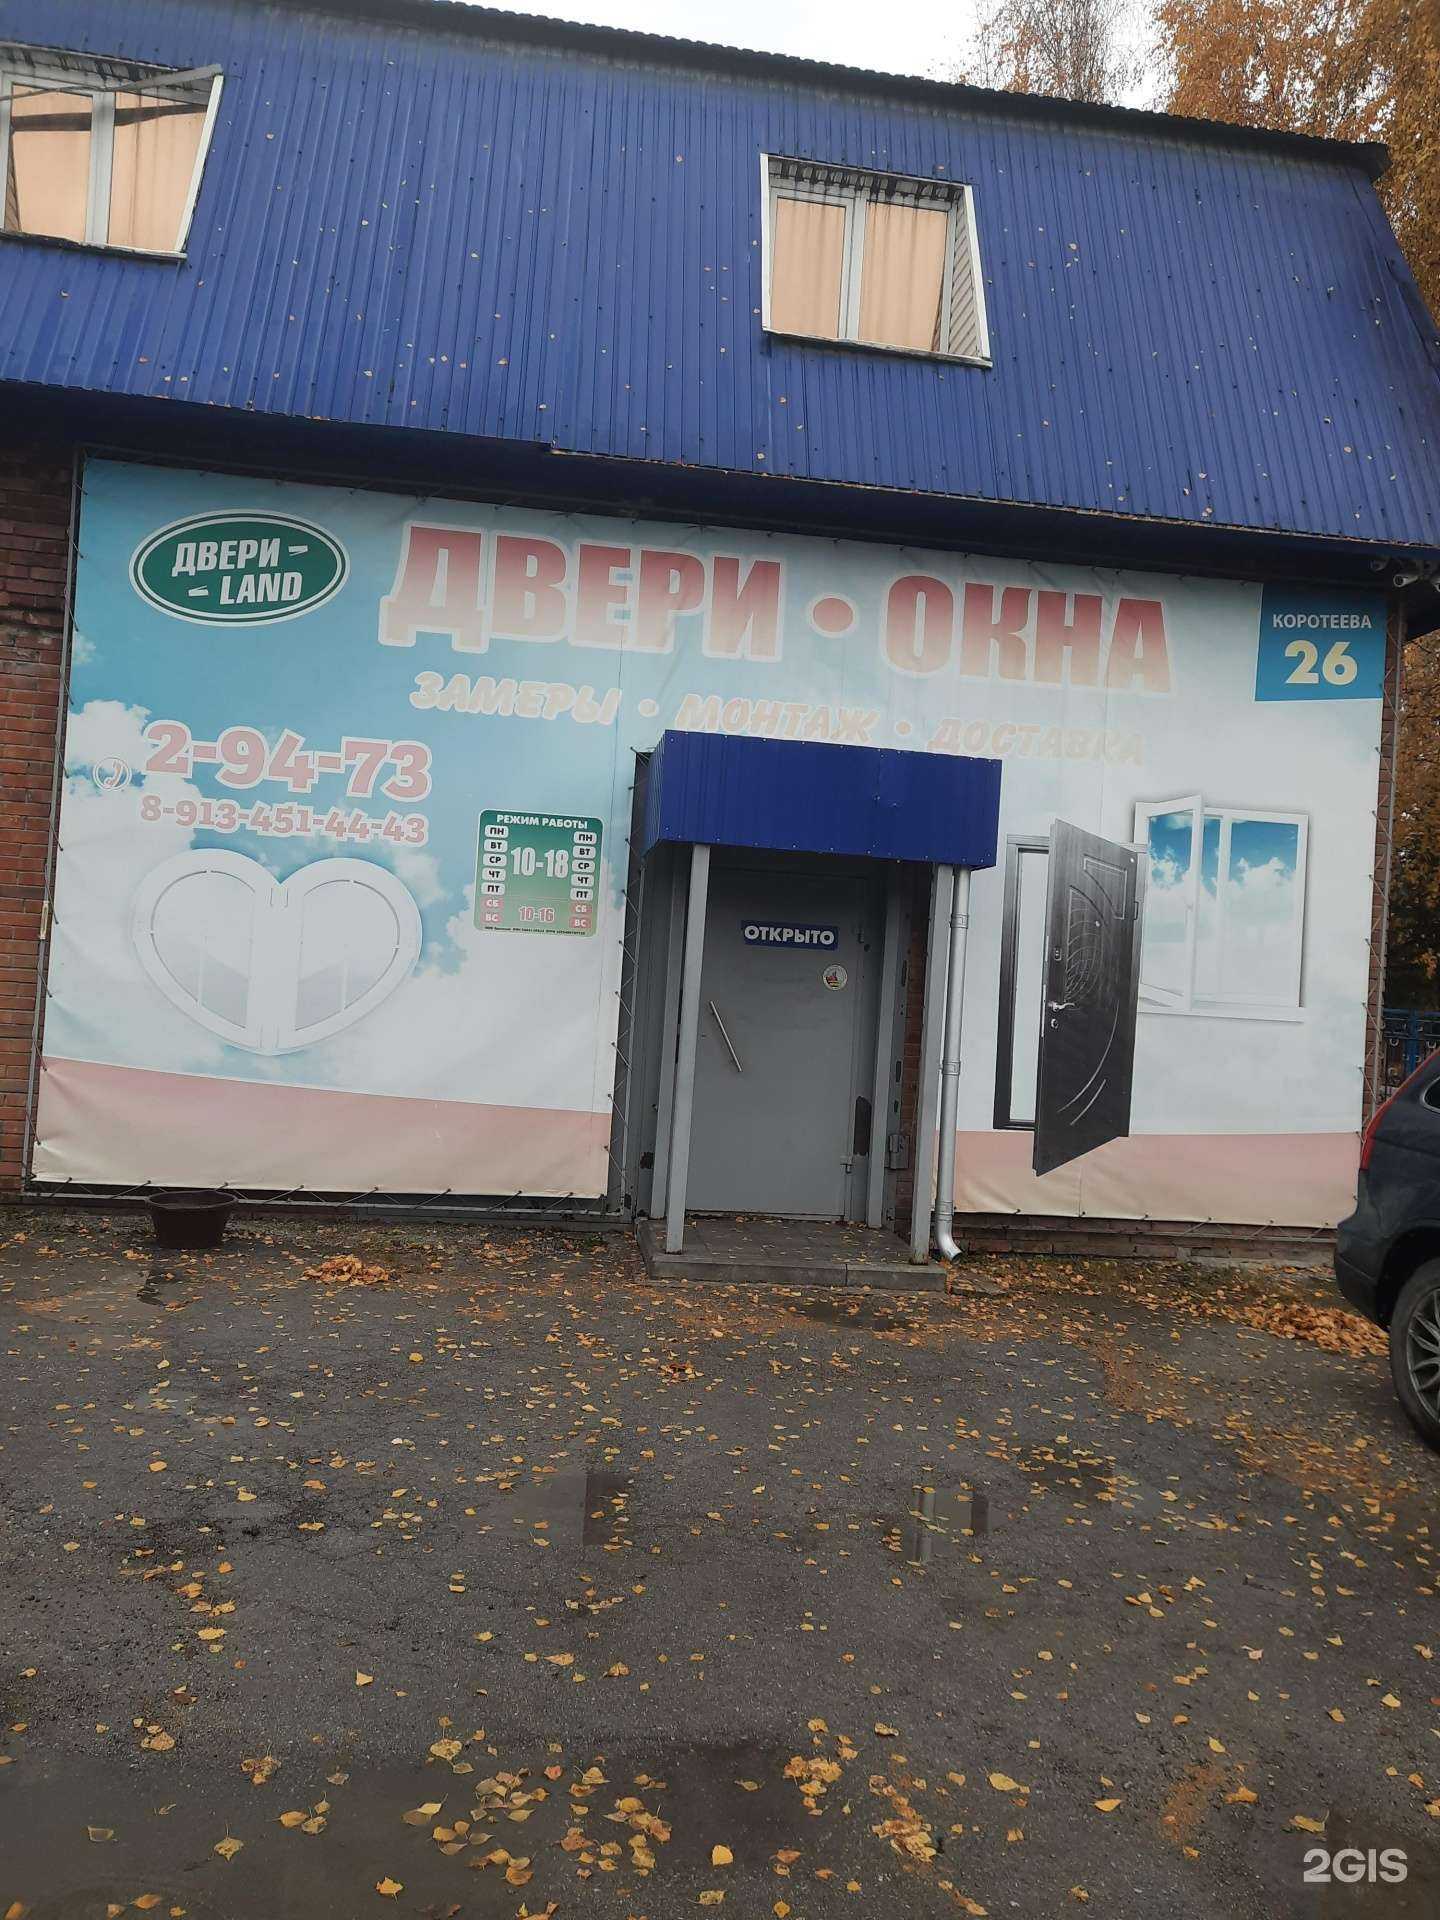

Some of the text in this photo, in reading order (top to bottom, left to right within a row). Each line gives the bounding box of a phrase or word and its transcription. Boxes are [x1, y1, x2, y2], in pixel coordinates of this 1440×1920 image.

[380, 523, 1175, 694] ДВЕРИ ОКНА
[1272, 613, 1372, 629] КОРОТЕЕВА
[1284, 639, 1358, 686] 26
[409, 671, 1144, 767] ЗАМЕРЫ МОНТАЖ ДОСТАВКА
[142, 719, 432, 802] 2-94-73
[138, 794, 430, 847] 8-913-451-44-43
[496, 814, 588, 830] РЕЖИМ РАБОТЫ
[489, 827, 505, 836] ПН
[578, 833, 593, 842] ПН
[490, 841, 502, 850] ВТ
[579, 847, 591, 856] ВТ
[489, 855, 502, 864] СР
[511, 846, 570, 879] 10-18
[577, 862, 590, 870] СР
[488, 870, 501, 879] ЧТ
[577, 876, 590, 885] ЧТ
[487, 884, 500, 893] ПТ
[576, 890, 589, 899] ПТ
[486, 899, 499, 908] СБ
[574, 904, 588, 913] СБ
[485, 913, 499, 922] ВС
[519, 905, 556, 923] 10-16
[574, 918, 587, 927] ВС
[744, 925, 835, 945] ОТКРЫТО
